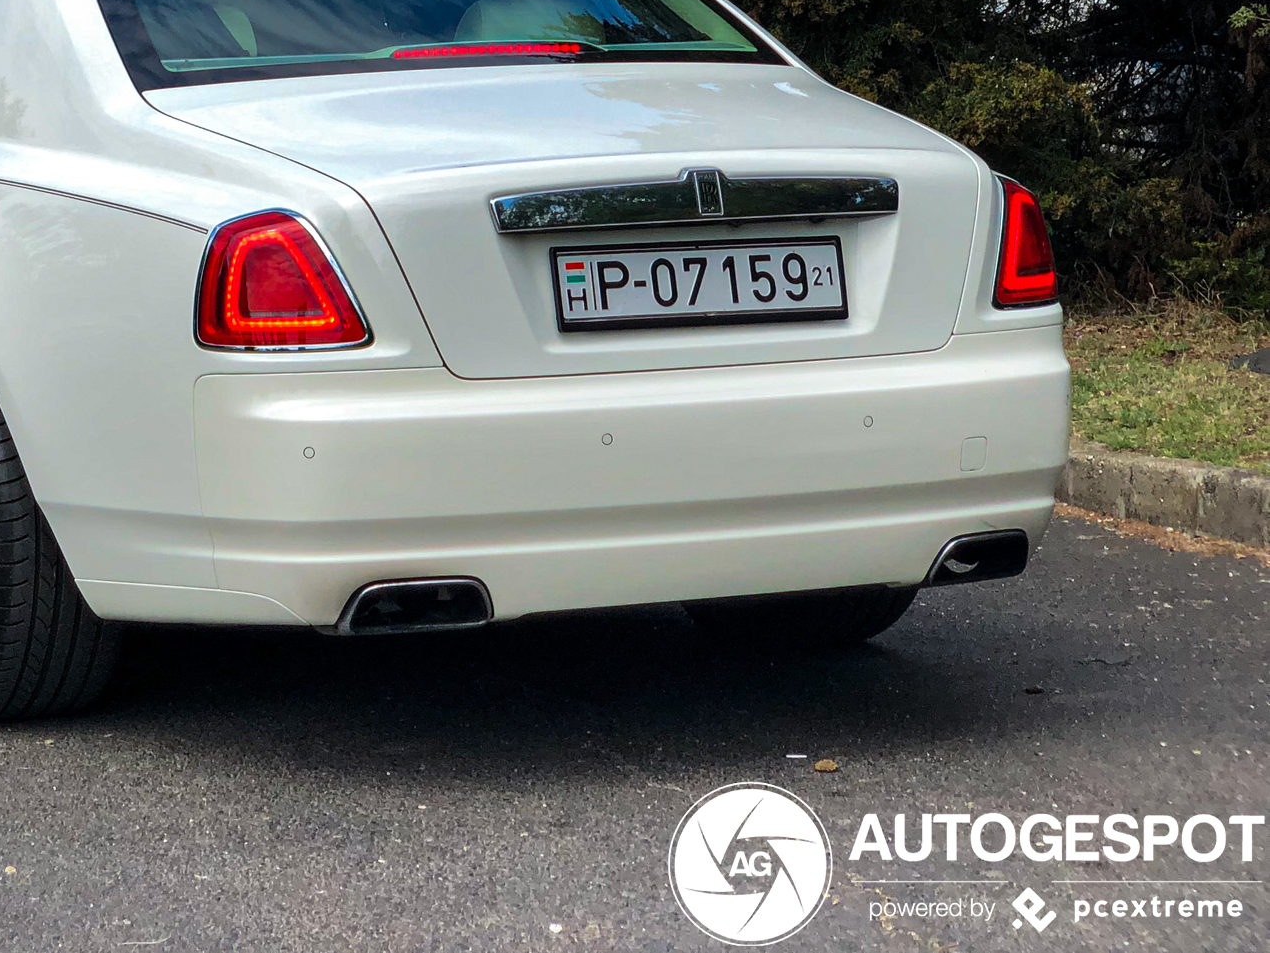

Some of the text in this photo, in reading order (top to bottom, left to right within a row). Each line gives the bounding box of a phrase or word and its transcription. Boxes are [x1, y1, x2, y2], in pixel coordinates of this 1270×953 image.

[567, 288, 588, 312] H
[596, 252, 834, 311] P-07159 21
